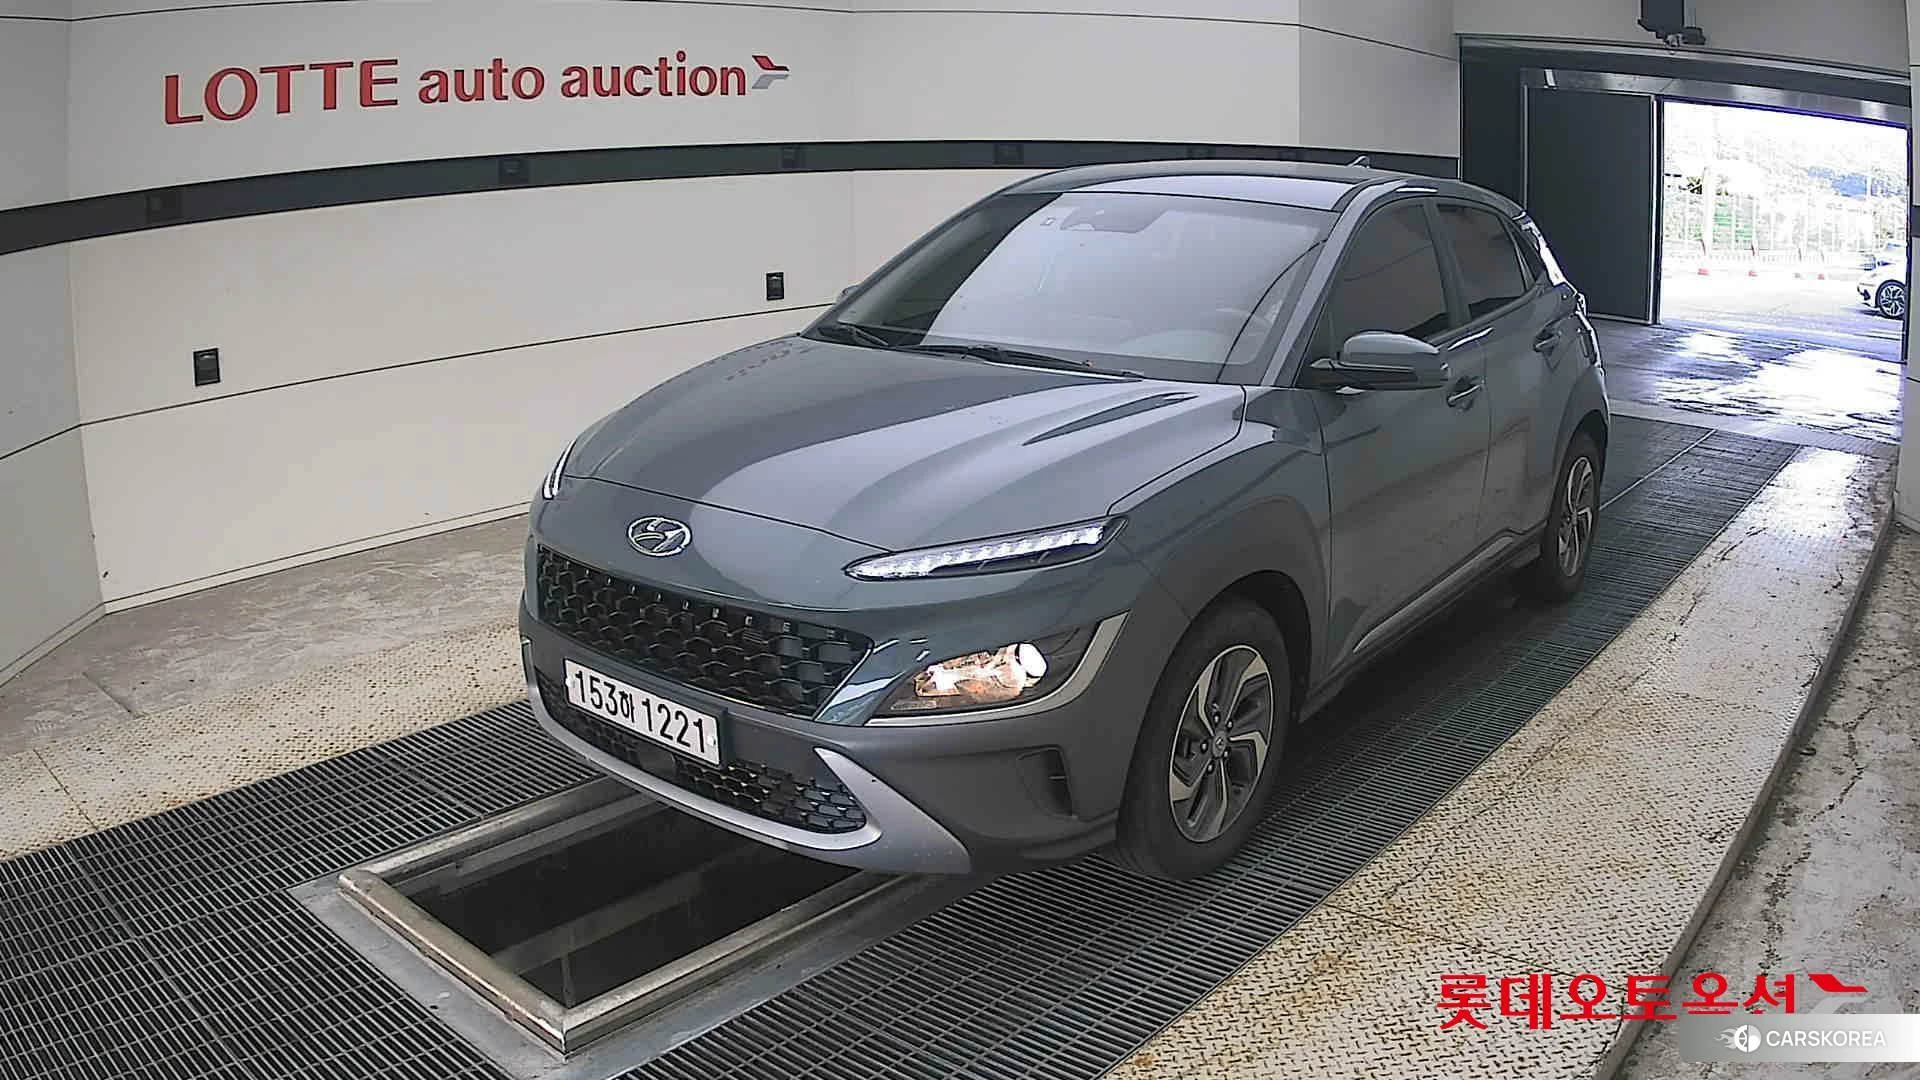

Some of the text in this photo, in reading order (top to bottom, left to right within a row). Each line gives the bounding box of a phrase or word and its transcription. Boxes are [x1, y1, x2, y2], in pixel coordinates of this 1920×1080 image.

[164, 50, 747, 125] LOTTE auto auction
[642, 697, 705, 754] 1221
